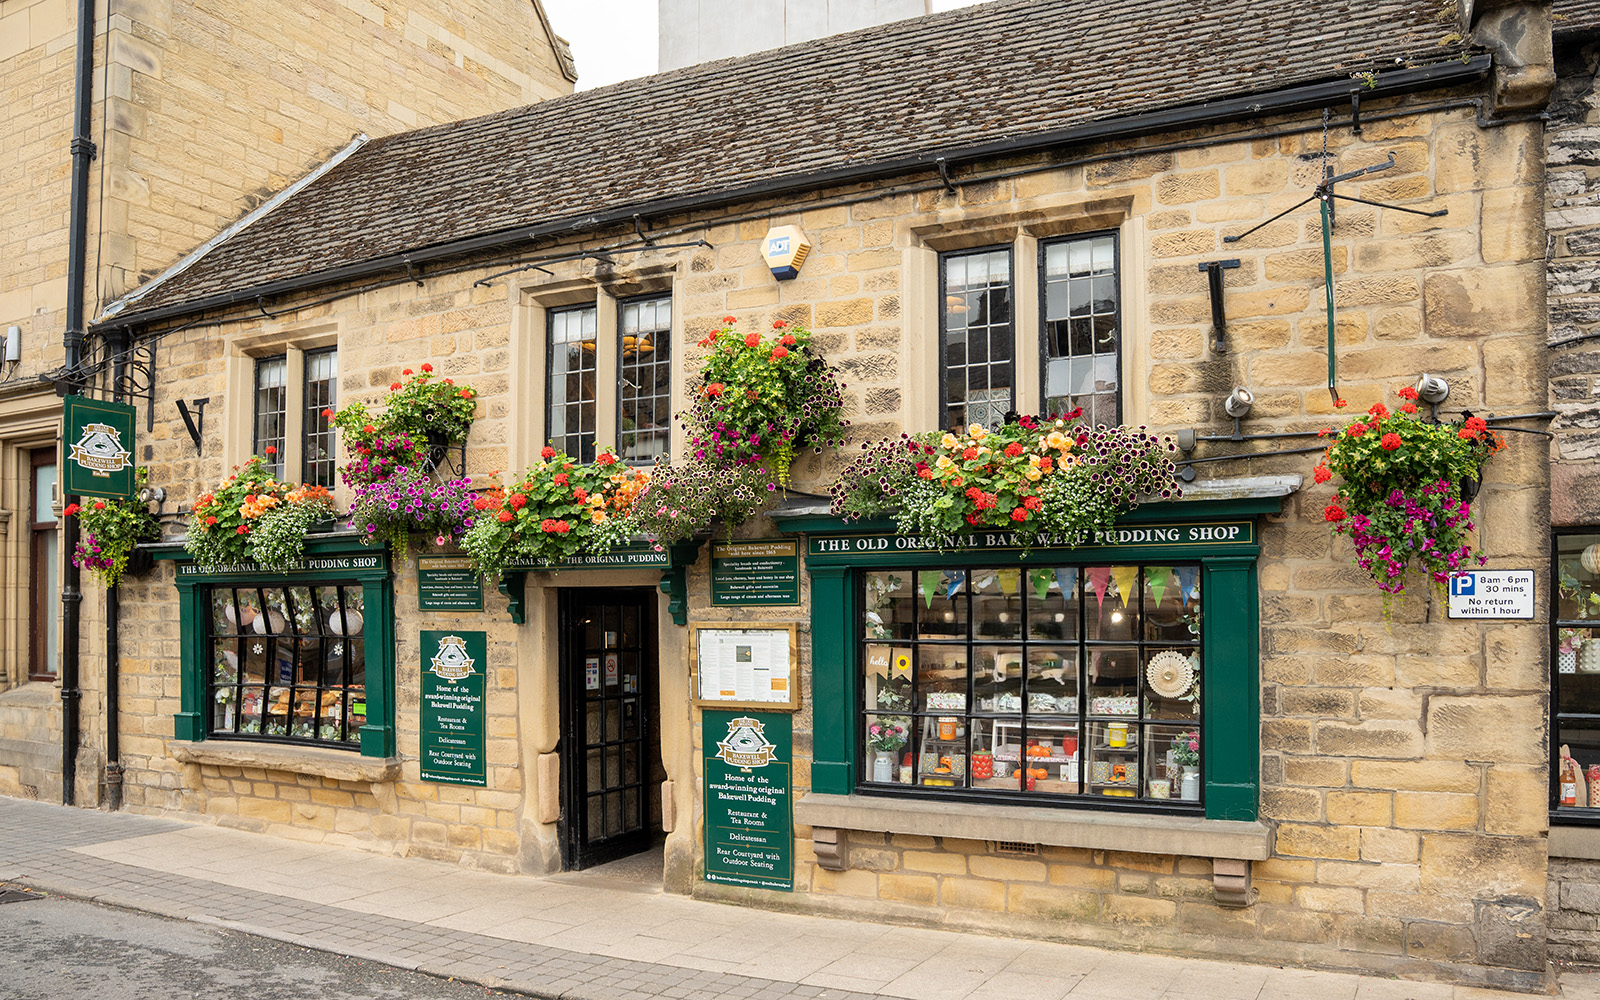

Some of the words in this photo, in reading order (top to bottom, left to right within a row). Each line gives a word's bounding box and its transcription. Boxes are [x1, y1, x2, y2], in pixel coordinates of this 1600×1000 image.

[770, 240, 790, 253] ADT
[81, 460, 106, 468] PUDDING
[818, 539, 850, 551] THE
[856, 538, 888, 550] OLD
[895, 535, 978, 549] ORIGNAL
[985, 532, 1086, 546] BAKWEL
[1094, 528, 1180, 543] PUDDING
[1189, 526, 1240, 540] SHOP
[309, 559, 349, 568] PUDDING
[353, 557, 377, 567] SHOP
[585, 555, 625, 563] ORIGINAL
[628, 554, 666, 562] PUDDING
[1457, 576, 1472, 594] P
[1508, 576, 1529, 584] 6pm
[870, 656, 888, 666] hello
[425, 693, 460, 702] award-winning
[453, 703, 474, 712] Pudding
[441, 751, 463, 759] Courtyard
[454, 760, 471, 768] Seating
[725, 774, 745, 782] Home
[709, 783, 757, 794] award-winning
[758, 786, 785, 795] original
[718, 792, 746, 801] Bakewell
[748, 794, 776, 805] Pudding
[728, 809, 759, 818] Restaurant
[733, 849, 763, 859] Courtyard
[723, 857, 748, 866] Outdoor
[750, 860, 774, 870] Seating
